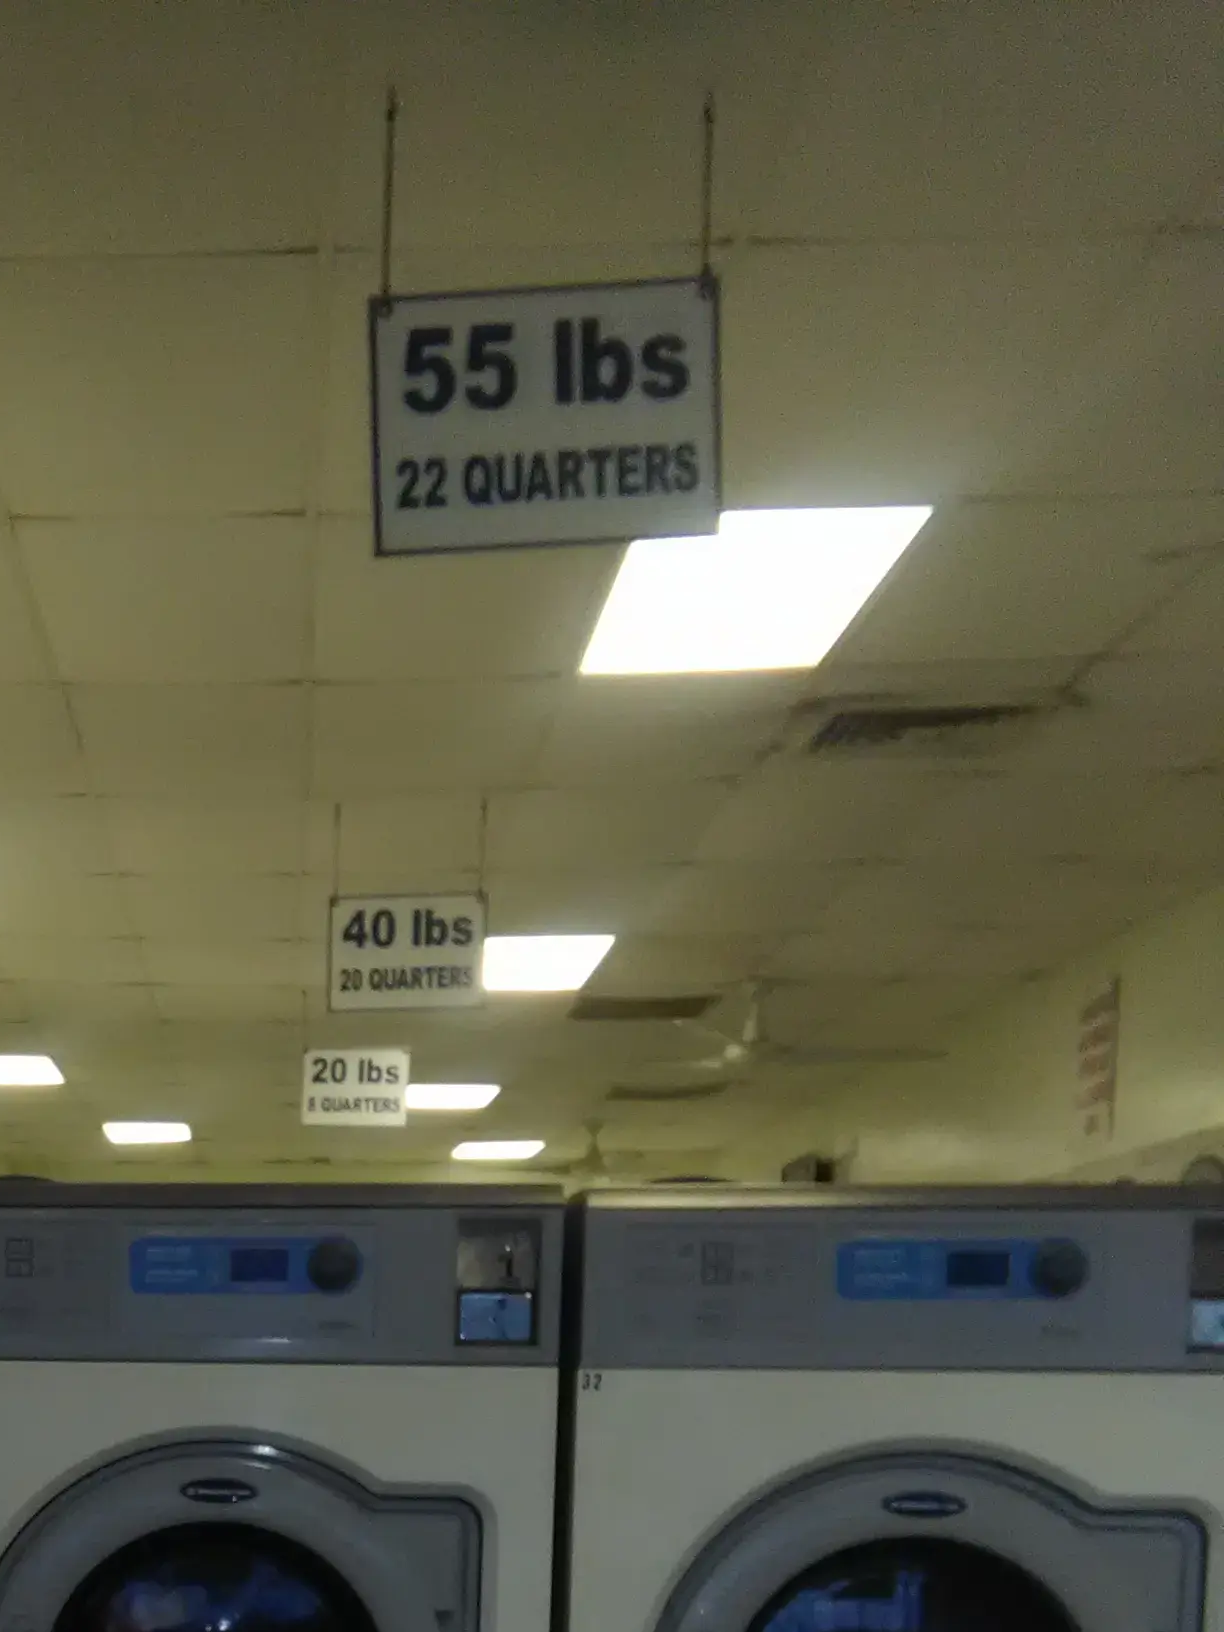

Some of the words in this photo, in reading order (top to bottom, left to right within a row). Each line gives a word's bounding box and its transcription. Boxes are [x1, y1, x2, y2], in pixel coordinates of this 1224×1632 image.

[403, 325, 518, 415] 55
[554, 317, 690, 406] lbs
[396, 457, 448, 510] 22
[464, 443, 700, 507] QUARTERS
[342, 908, 396, 949] 40
[411, 908, 473, 947] lbs
[340, 967, 363, 993] 20
[369, 964, 473, 993] QUARTERS
[312, 1057, 347, 1084] 20
[359, 1057, 399, 1084] lbs
